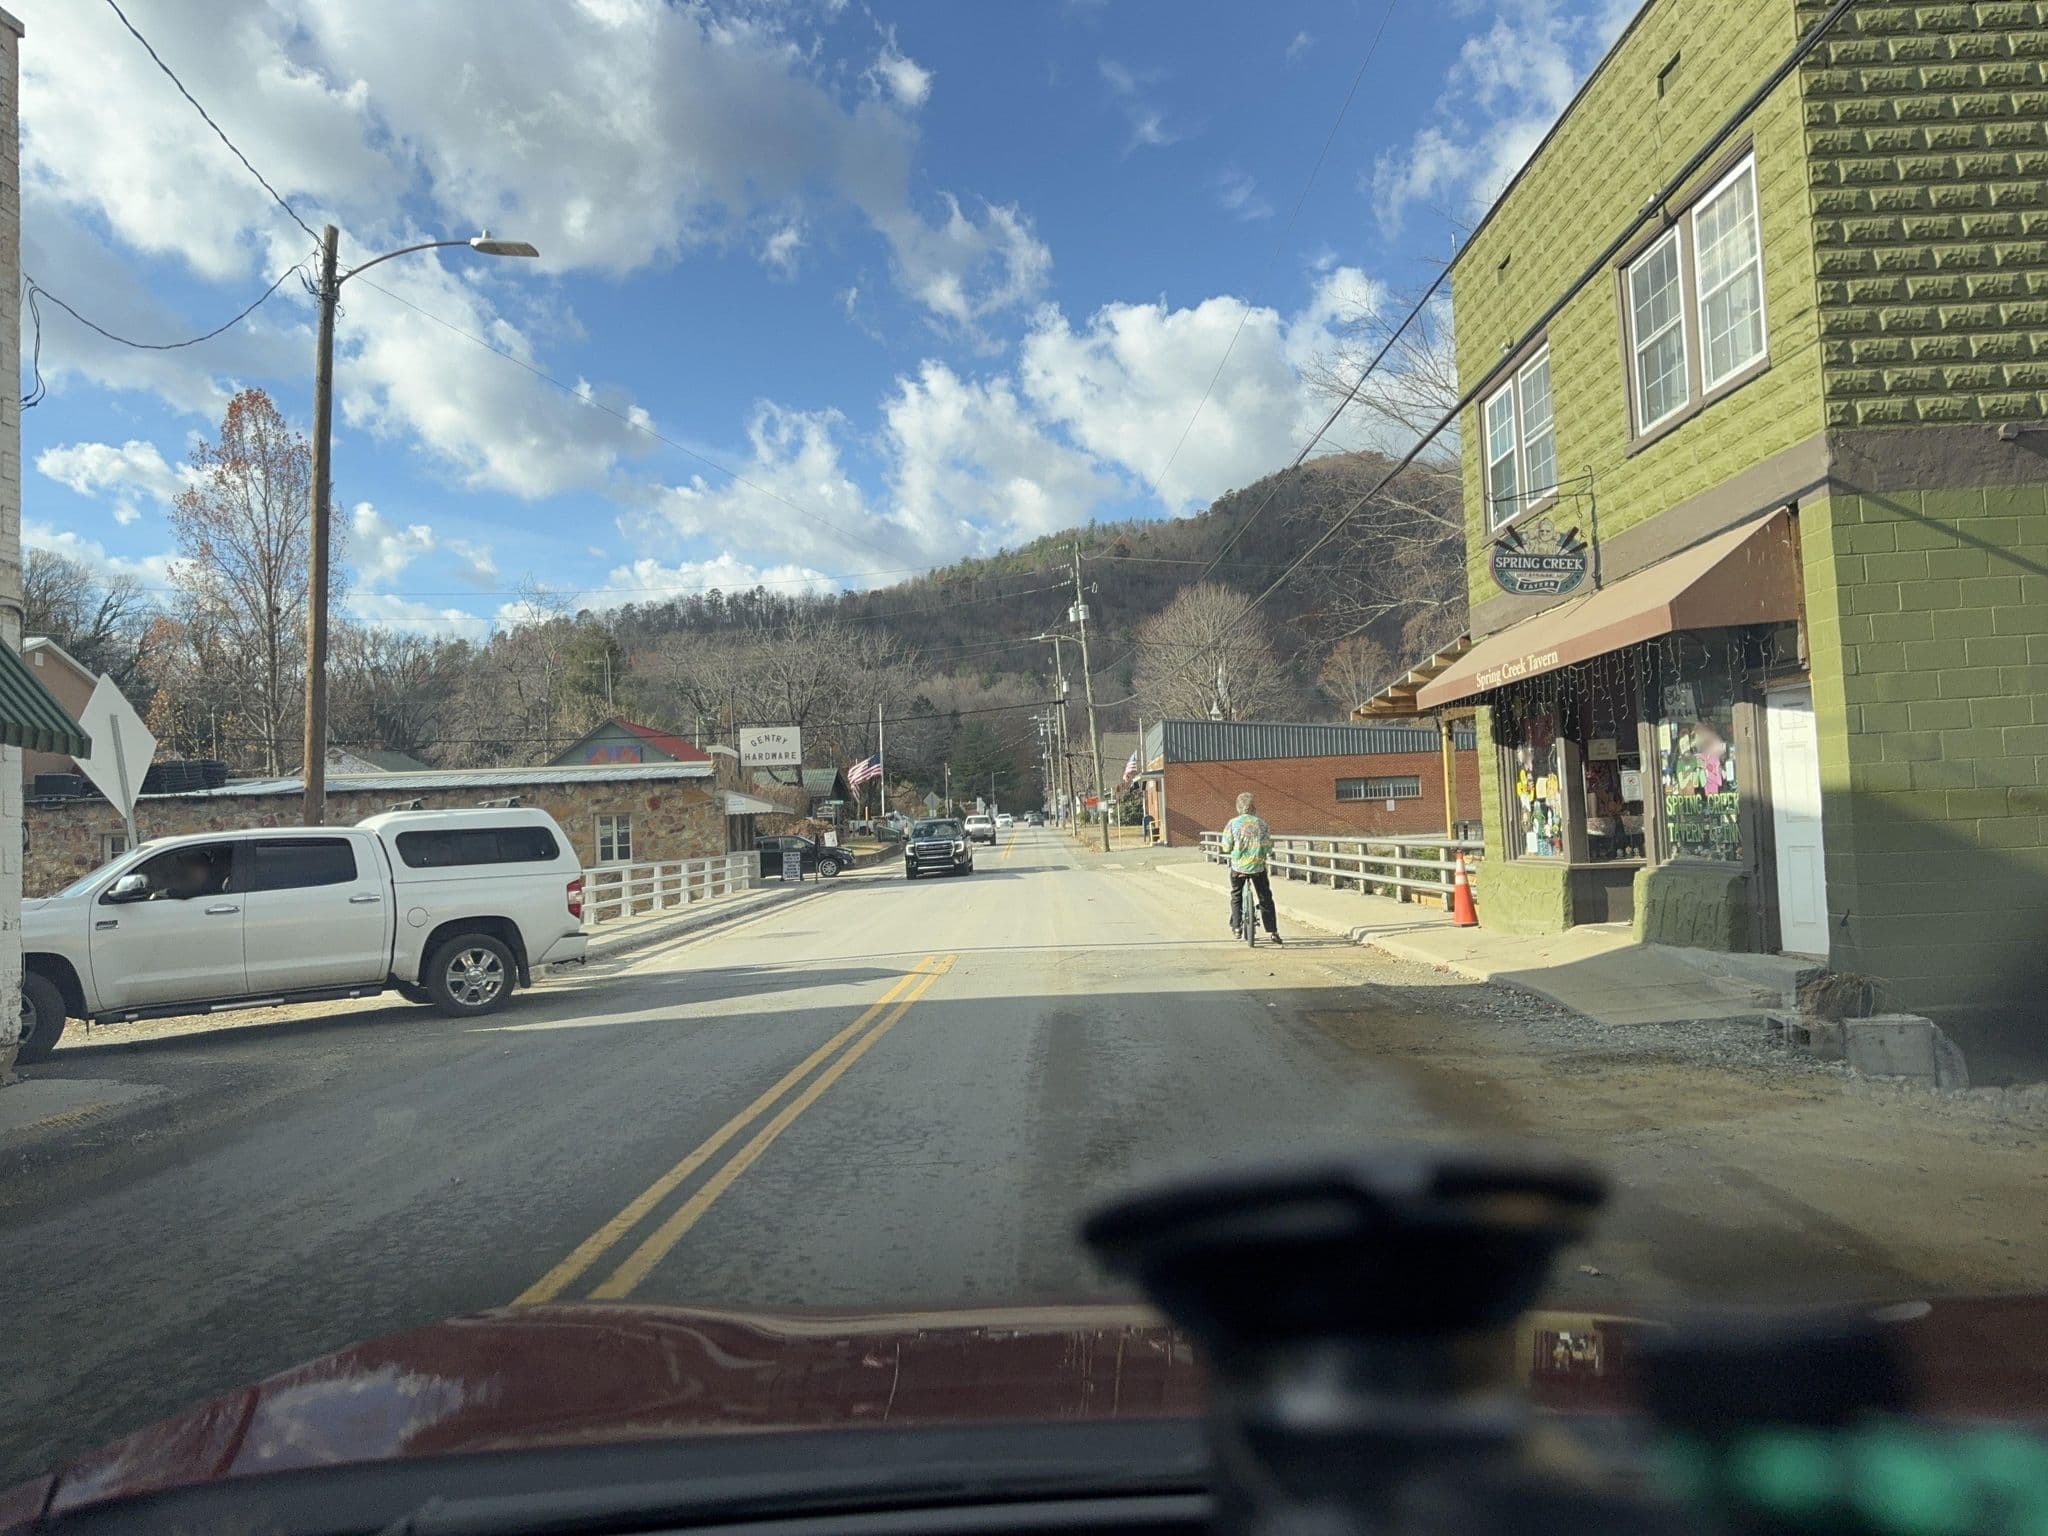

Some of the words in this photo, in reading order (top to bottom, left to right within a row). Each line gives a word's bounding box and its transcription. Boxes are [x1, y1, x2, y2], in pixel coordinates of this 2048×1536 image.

[1495, 556, 1540, 569] SPRING
[1543, 557, 1584, 570] CREEK
[1523, 581, 1556, 590] TAVERN
[1476, 667, 1502, 690] Spring
[1502, 657, 1527, 680] Creek
[1527, 650, 1559, 670] Tavern
[750, 734, 789, 747] GENTRY
[744, 751, 797, 761] HARDWARE
[1666, 793, 1703, 816] SPRING
[1707, 792, 1740, 814] CREEK
[1667, 822, 1704, 842] TAVERN
